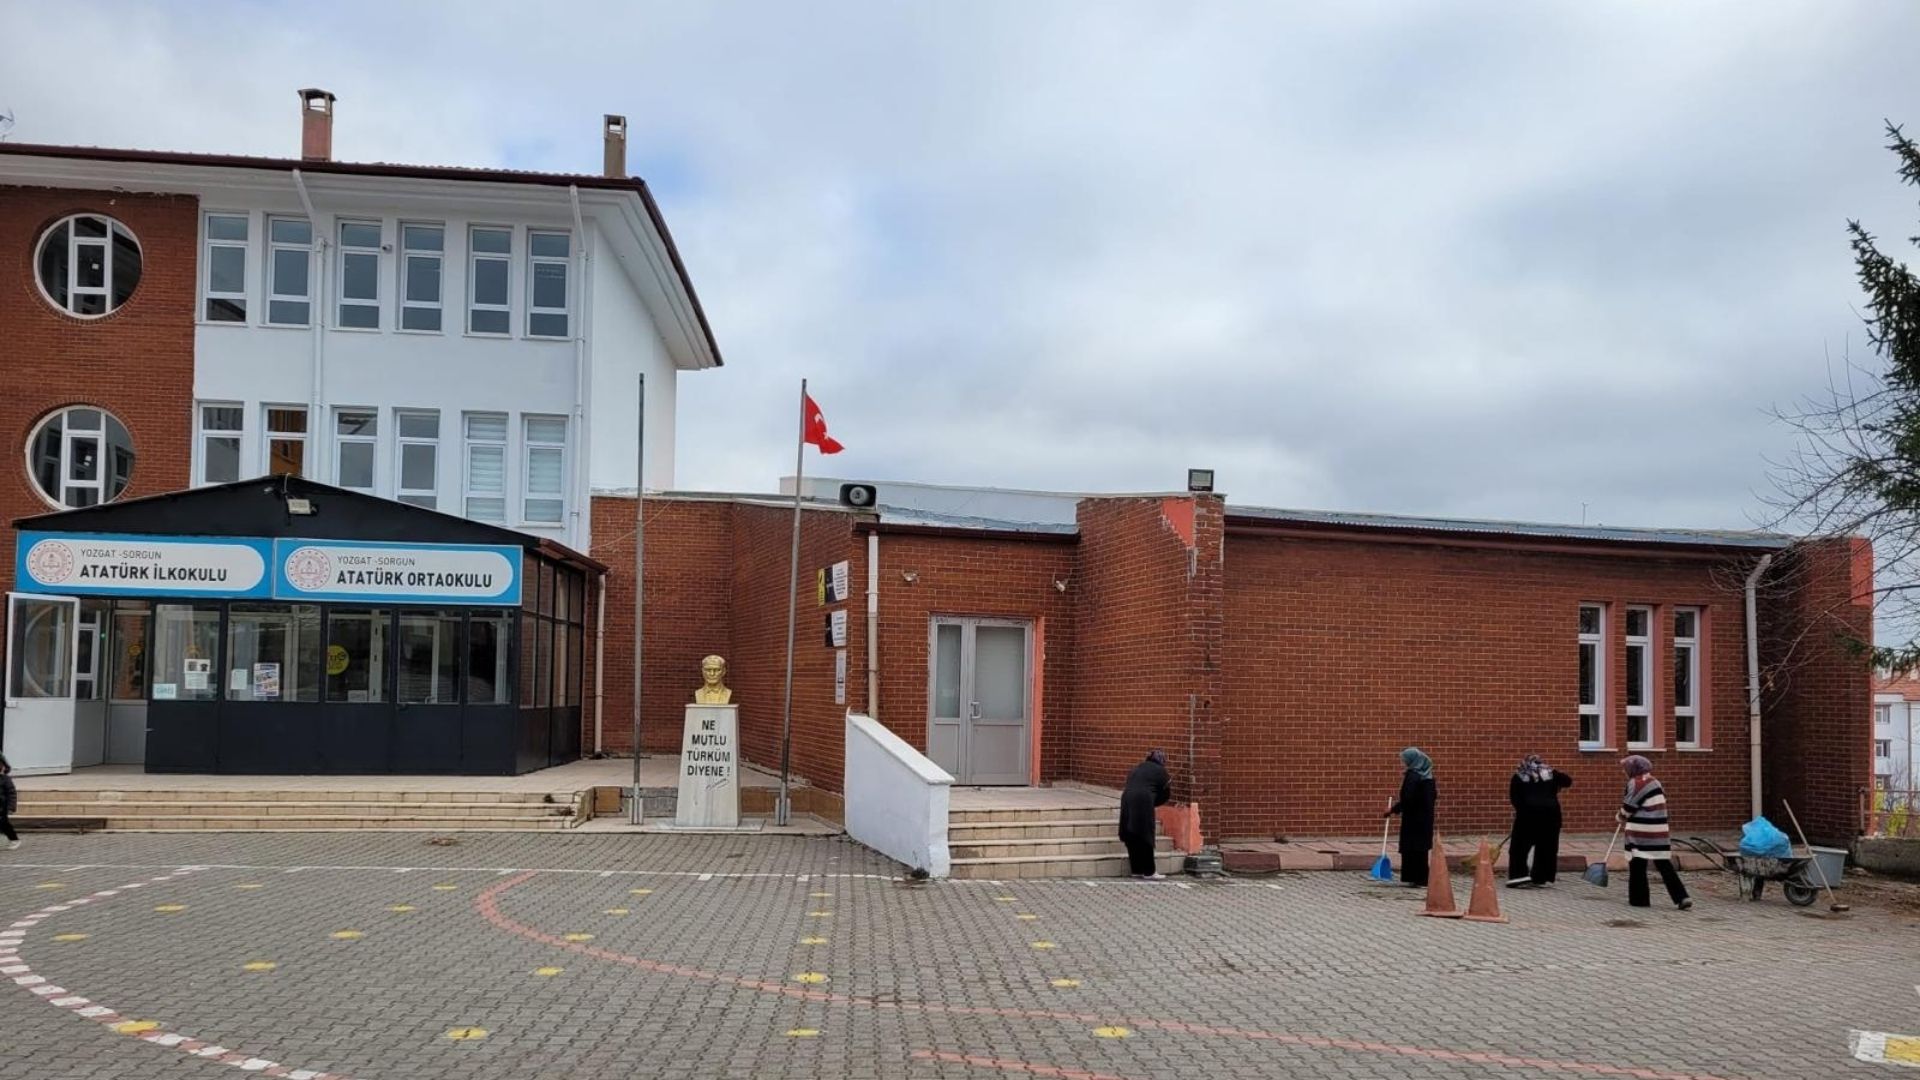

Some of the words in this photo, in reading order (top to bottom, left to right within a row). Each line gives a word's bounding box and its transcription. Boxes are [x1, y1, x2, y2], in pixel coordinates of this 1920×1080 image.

[81, 549, 116, 558] YOZGAT
[337, 556, 372, 565] YOZGAT
[80, 562, 149, 580] ATATÜRK
[153, 563, 227, 582] İLKOKULU
[337, 567, 404, 586] ATATÜRK
[407, 572, 492, 588] ORTAOKULU
[702, 720, 716, 731] NE
[692, 734, 727, 746] MUTLU
[687, 748, 731, 762] TÜRKÜM
[687, 763, 724, 777] DİYENE
